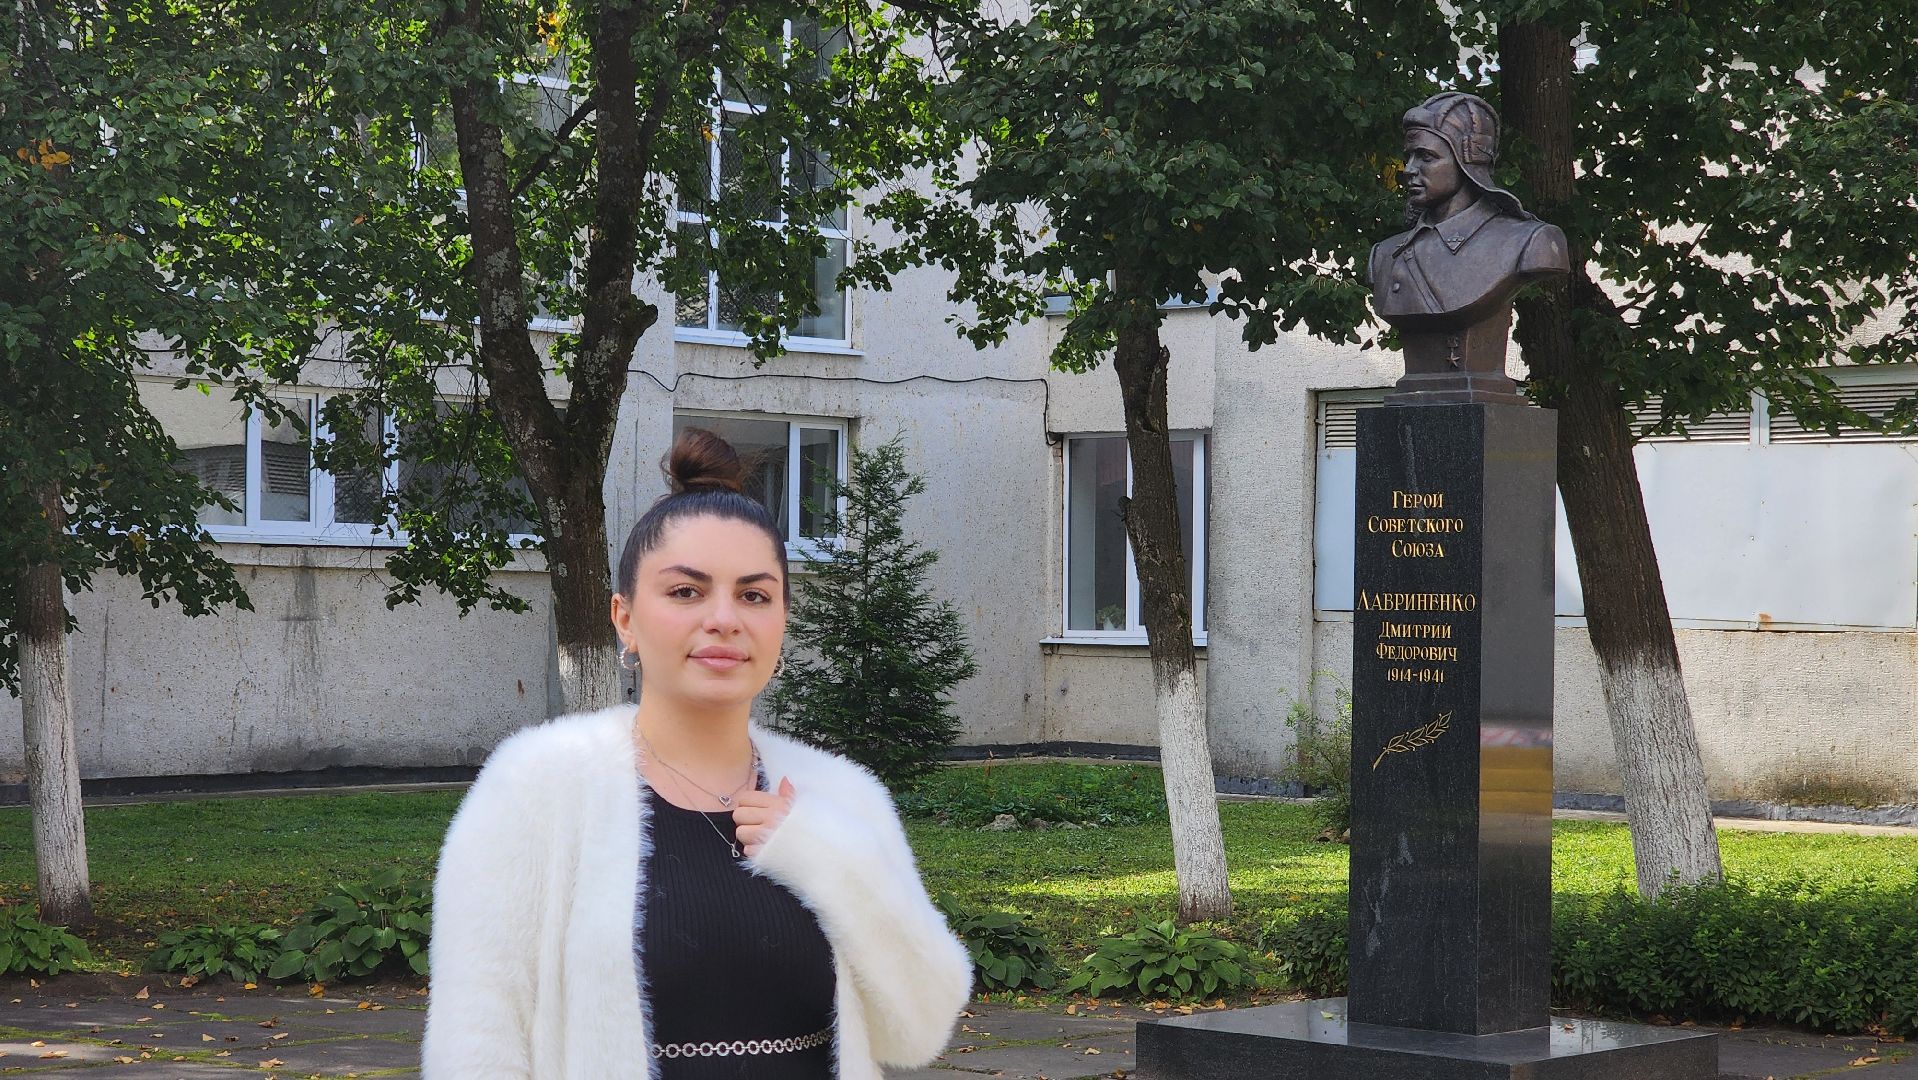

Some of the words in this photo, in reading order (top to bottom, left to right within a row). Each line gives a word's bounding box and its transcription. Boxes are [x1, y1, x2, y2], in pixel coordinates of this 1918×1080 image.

[1392, 490, 1444, 509] ГЕРОЙ
[1368, 515, 1464, 533] СОВЕТСКОГО
[1391, 539, 1445, 558] СОЮЗА
[1356, 588, 1476, 612] ЛАВРИНЕНКО
[1378, 621, 1452, 640] ДМИТРИЙ
[1375, 642, 1458, 662] ФЕДОРОВИЧ
[1387, 667, 1444, 683] 1914-1941
